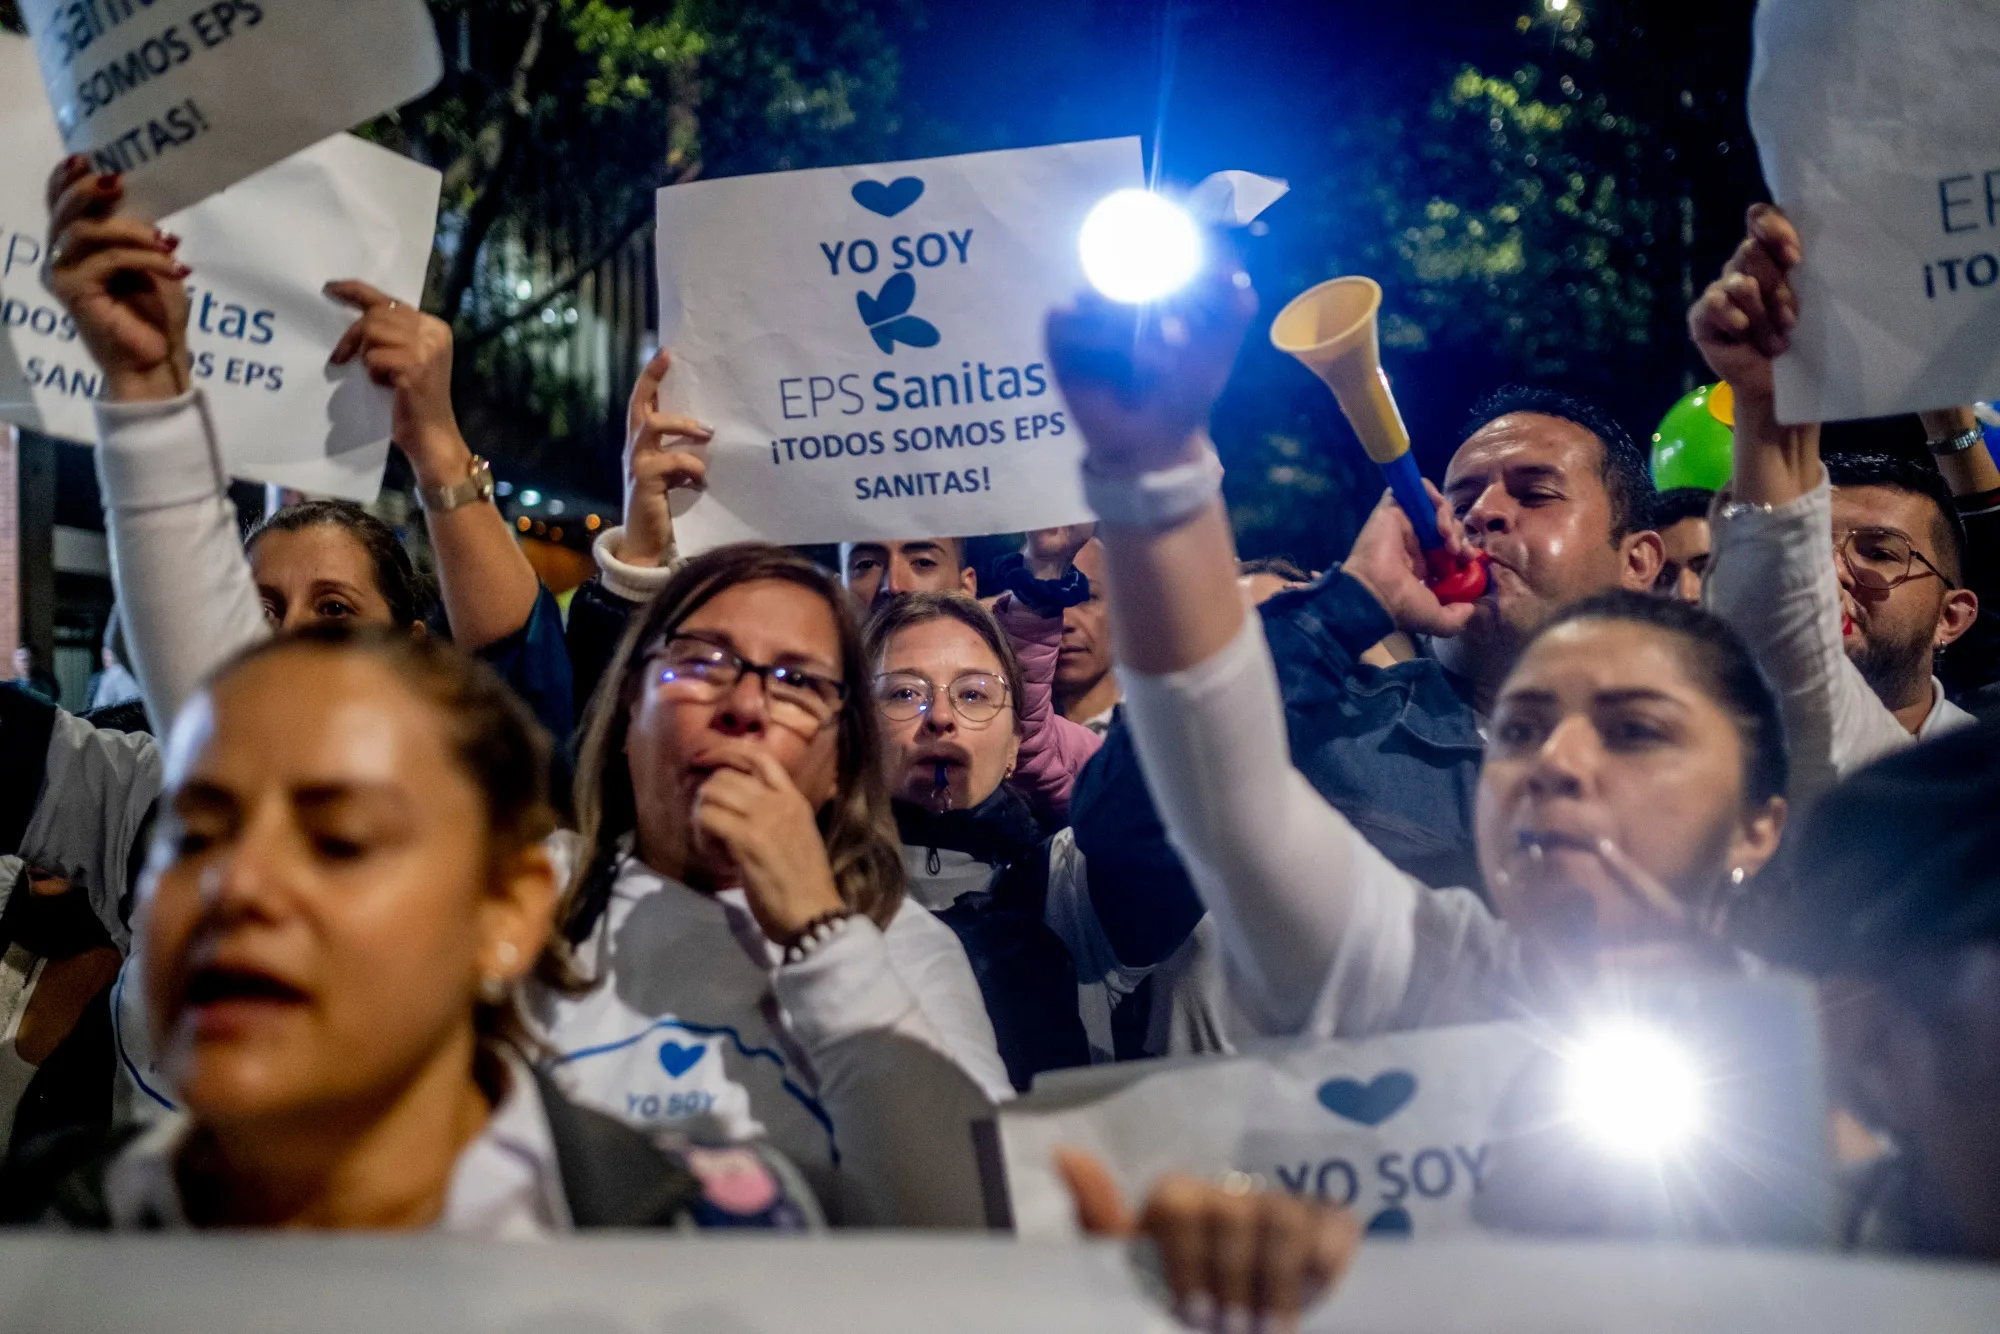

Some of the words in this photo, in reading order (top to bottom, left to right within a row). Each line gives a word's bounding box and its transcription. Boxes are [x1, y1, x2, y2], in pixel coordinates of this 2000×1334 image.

[78, 25, 193, 118] SOMOS
[190, 0, 263, 48] EPS
[90, 98, 210, 177] NITAS!
[820, 239, 880, 276] YO
[892, 229, 974, 272] SOY
[25, 356, 97, 398] SAN
[225, 357, 284, 391] EPS
[780, 373, 865, 420] EPS
[872, 361, 1046, 412] Sanitas
[772, 430, 886, 465] ¡TODOS
[892, 419, 1007, 454] SOMOS
[1014, 412, 1066, 442] EPS
[854, 466, 991, 501] SANITAS!
[1276, 1157, 1359, 1208] YO
[1375, 1143, 1488, 1202] SOY
